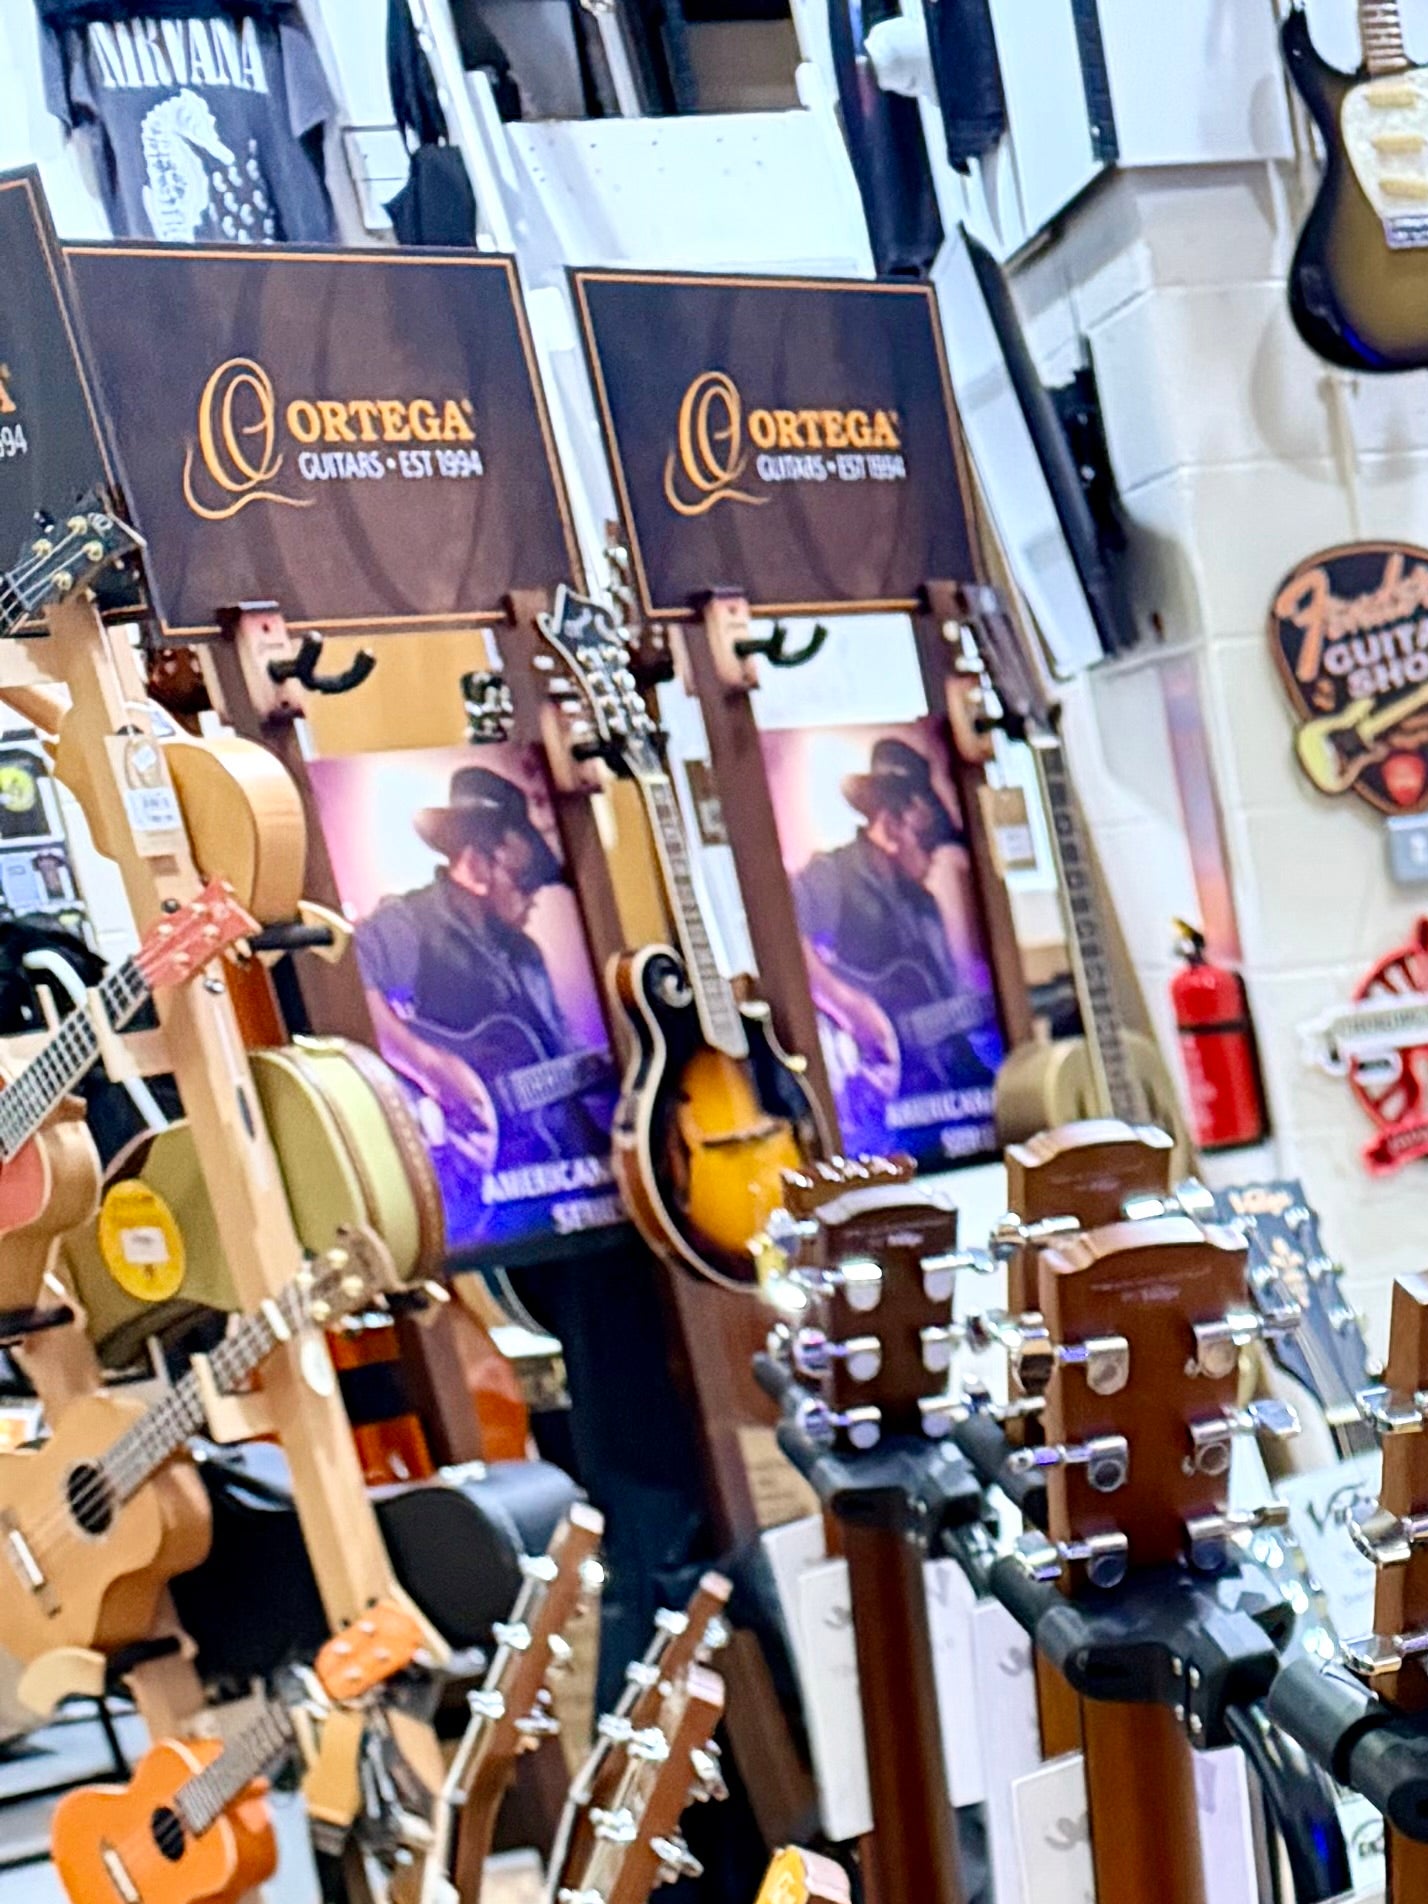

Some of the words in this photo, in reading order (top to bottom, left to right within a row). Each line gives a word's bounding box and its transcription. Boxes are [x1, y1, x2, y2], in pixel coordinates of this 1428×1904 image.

[88, 16, 269, 94] NIRVANA
[287, 399, 476, 442] ORTEGA
[748, 409, 901, 449] ORTEGA
[0, 424, 28, 458] 94
[299, 450, 386, 480] GUITARS
[400, 450, 433, 479] EST
[436, 450, 484, 479] 1994
[835, 453, 866, 481] EST
